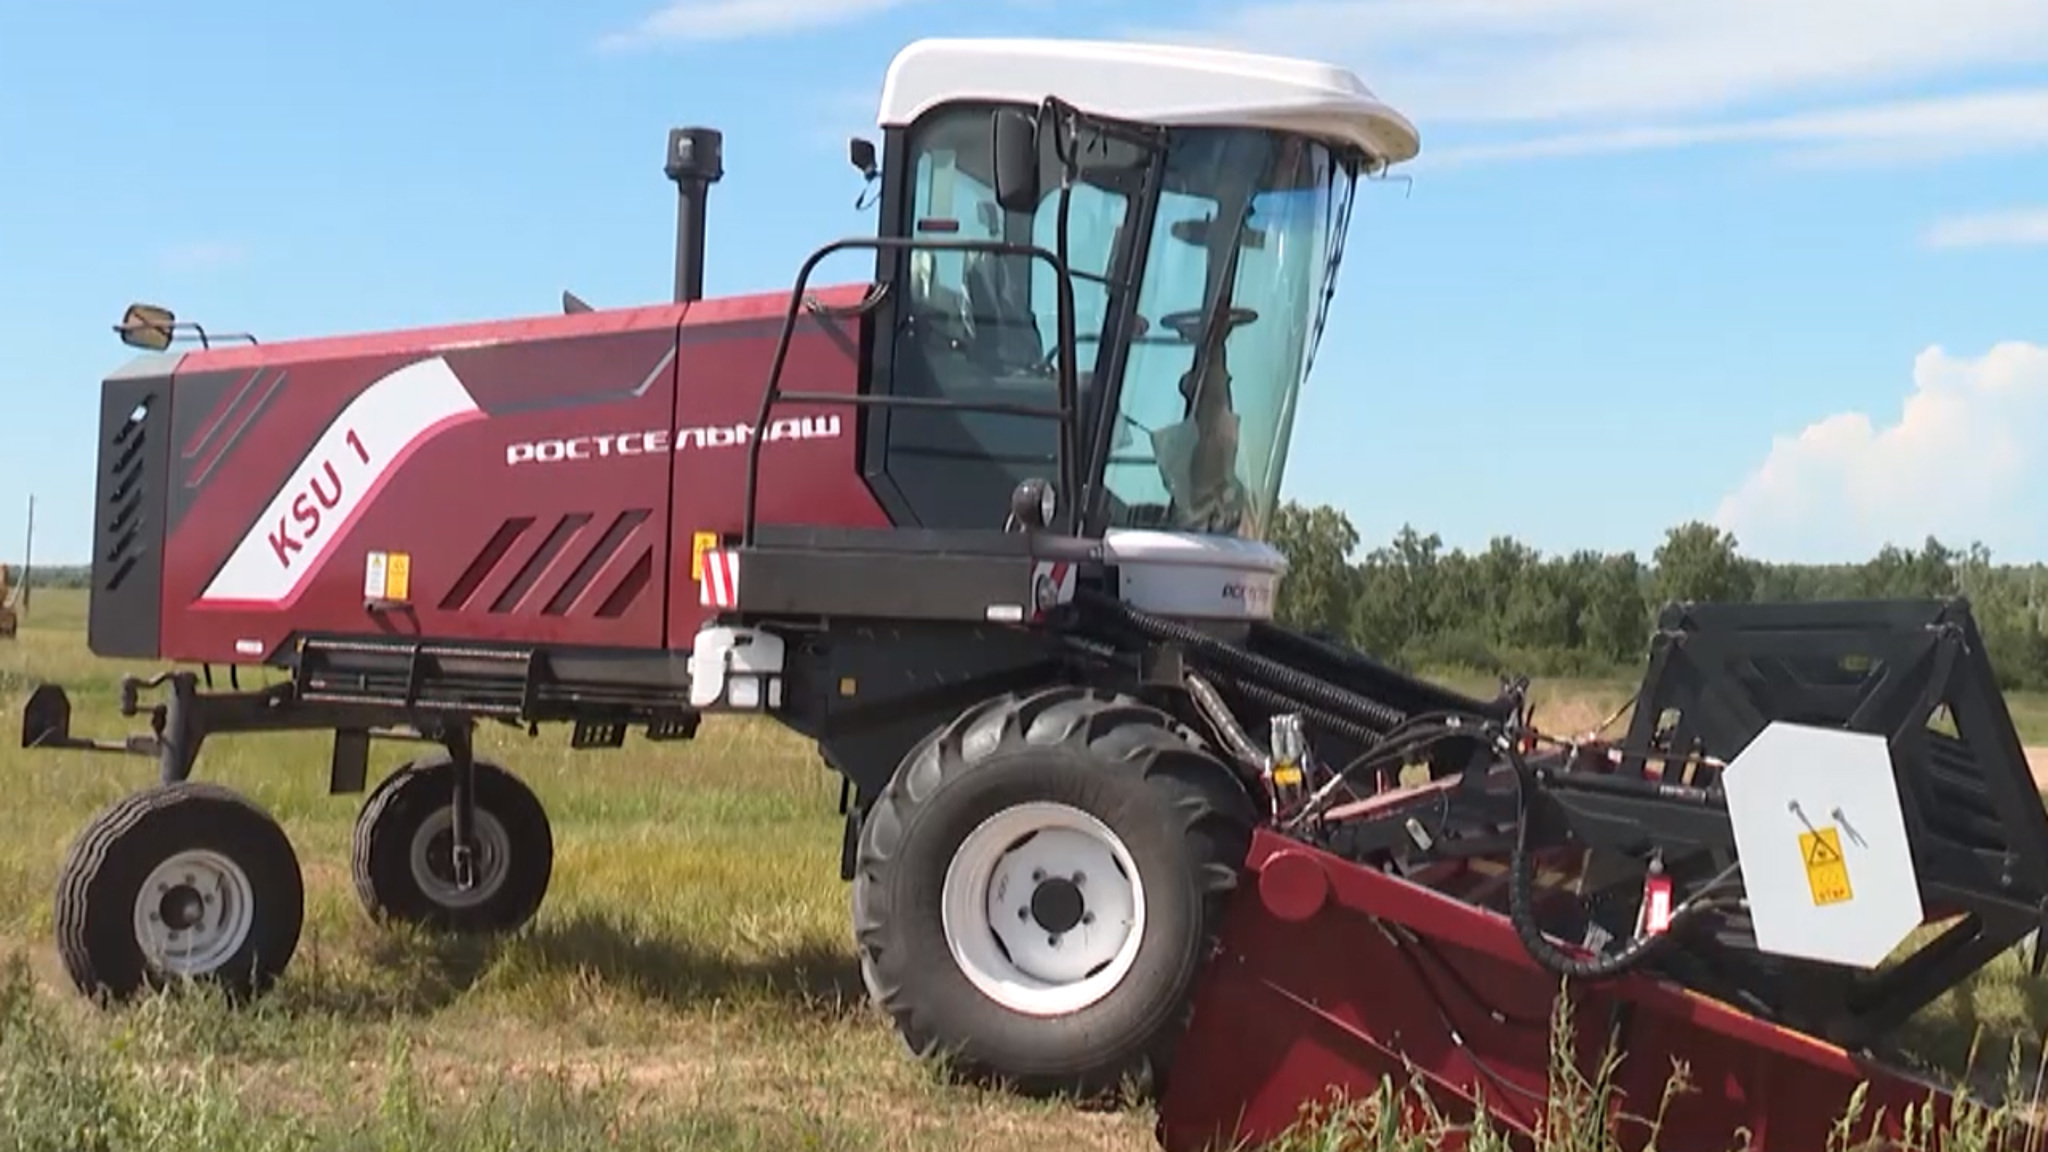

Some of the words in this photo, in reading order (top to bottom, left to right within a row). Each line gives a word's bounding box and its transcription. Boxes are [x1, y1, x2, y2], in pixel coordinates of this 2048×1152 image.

[505, 414, 842, 466] РОСТСЕЛЬМАШ
[267, 459, 343, 569] KSU
[344, 427, 371, 466] 1
